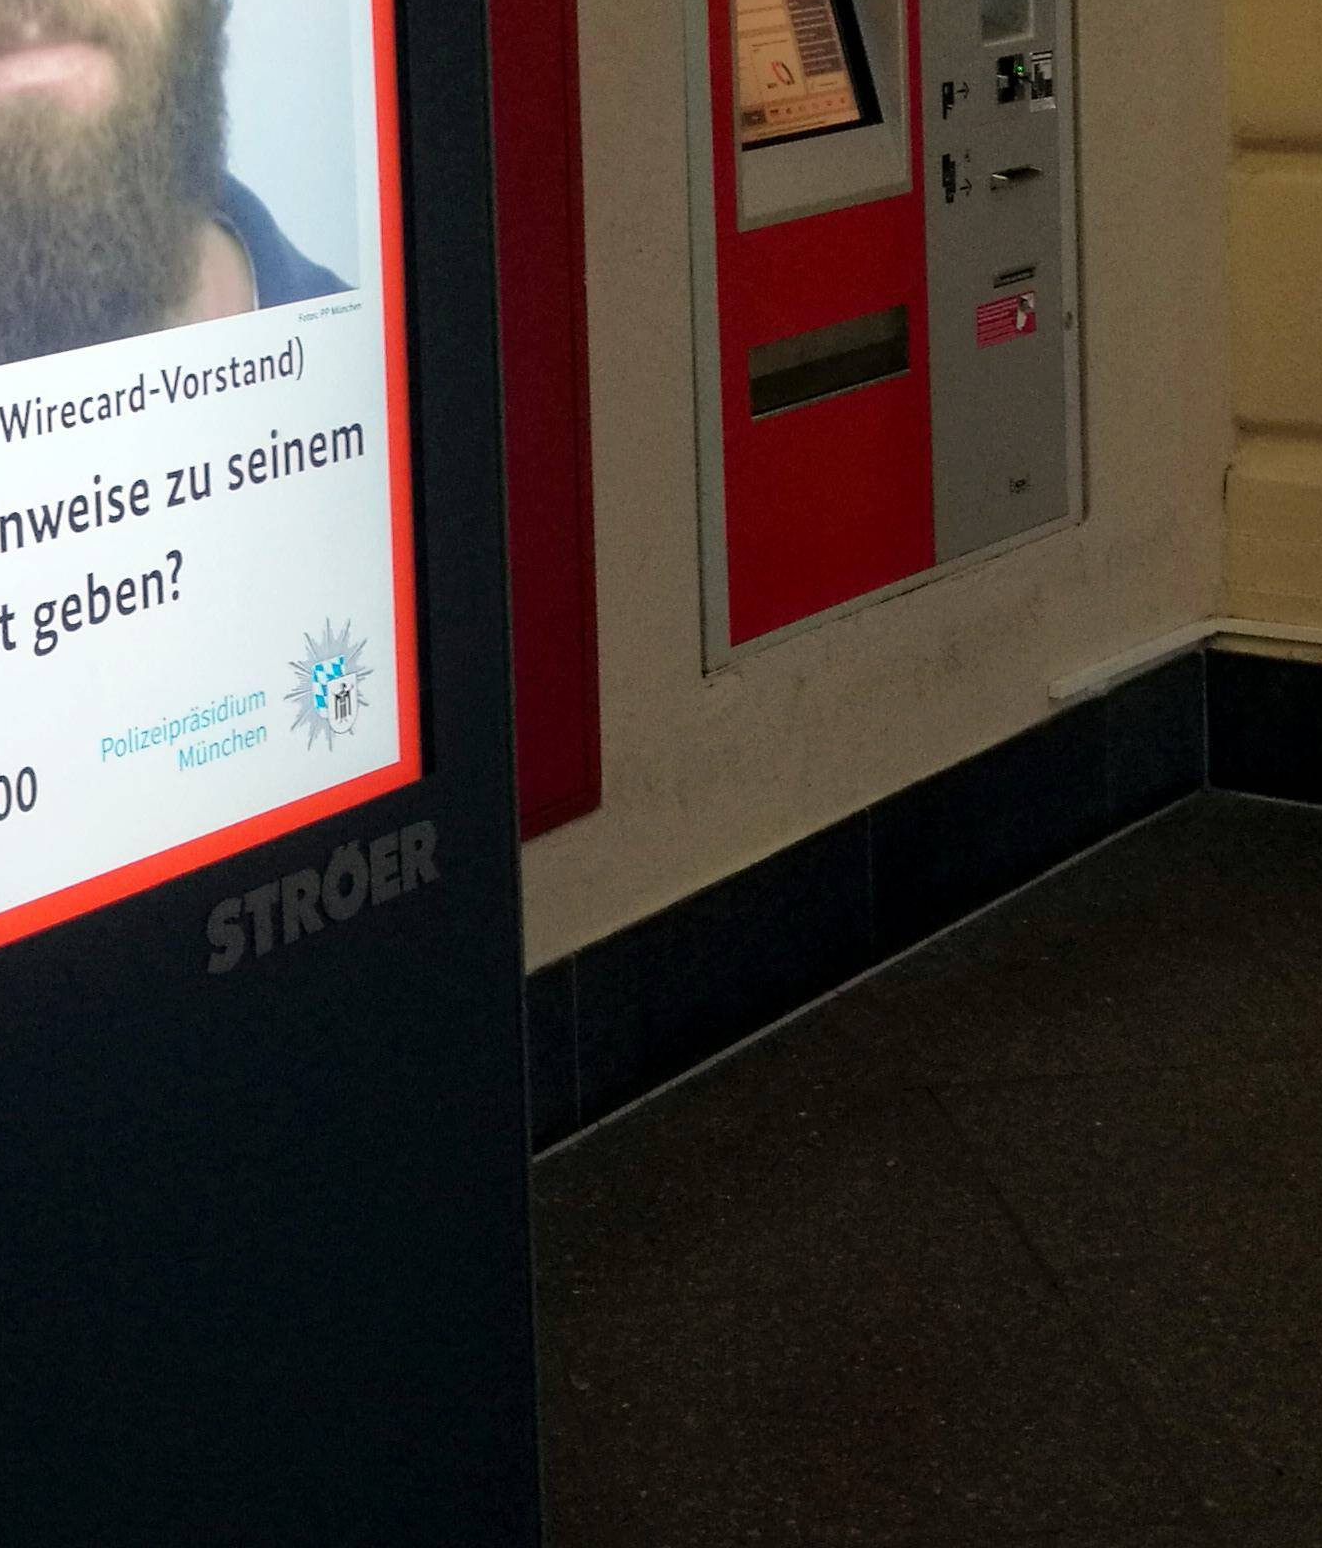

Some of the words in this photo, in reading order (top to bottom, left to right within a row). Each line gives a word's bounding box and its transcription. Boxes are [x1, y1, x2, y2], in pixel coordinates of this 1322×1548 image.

[166, 463, 213, 508] zu
[227, 420, 366, 492] seinem
[33, 549, 186, 657] geben?
[101, 690, 267, 763] Polizeipräsidium
[178, 723, 269, 772] München
[207, 819, 442, 975] STRÖER
